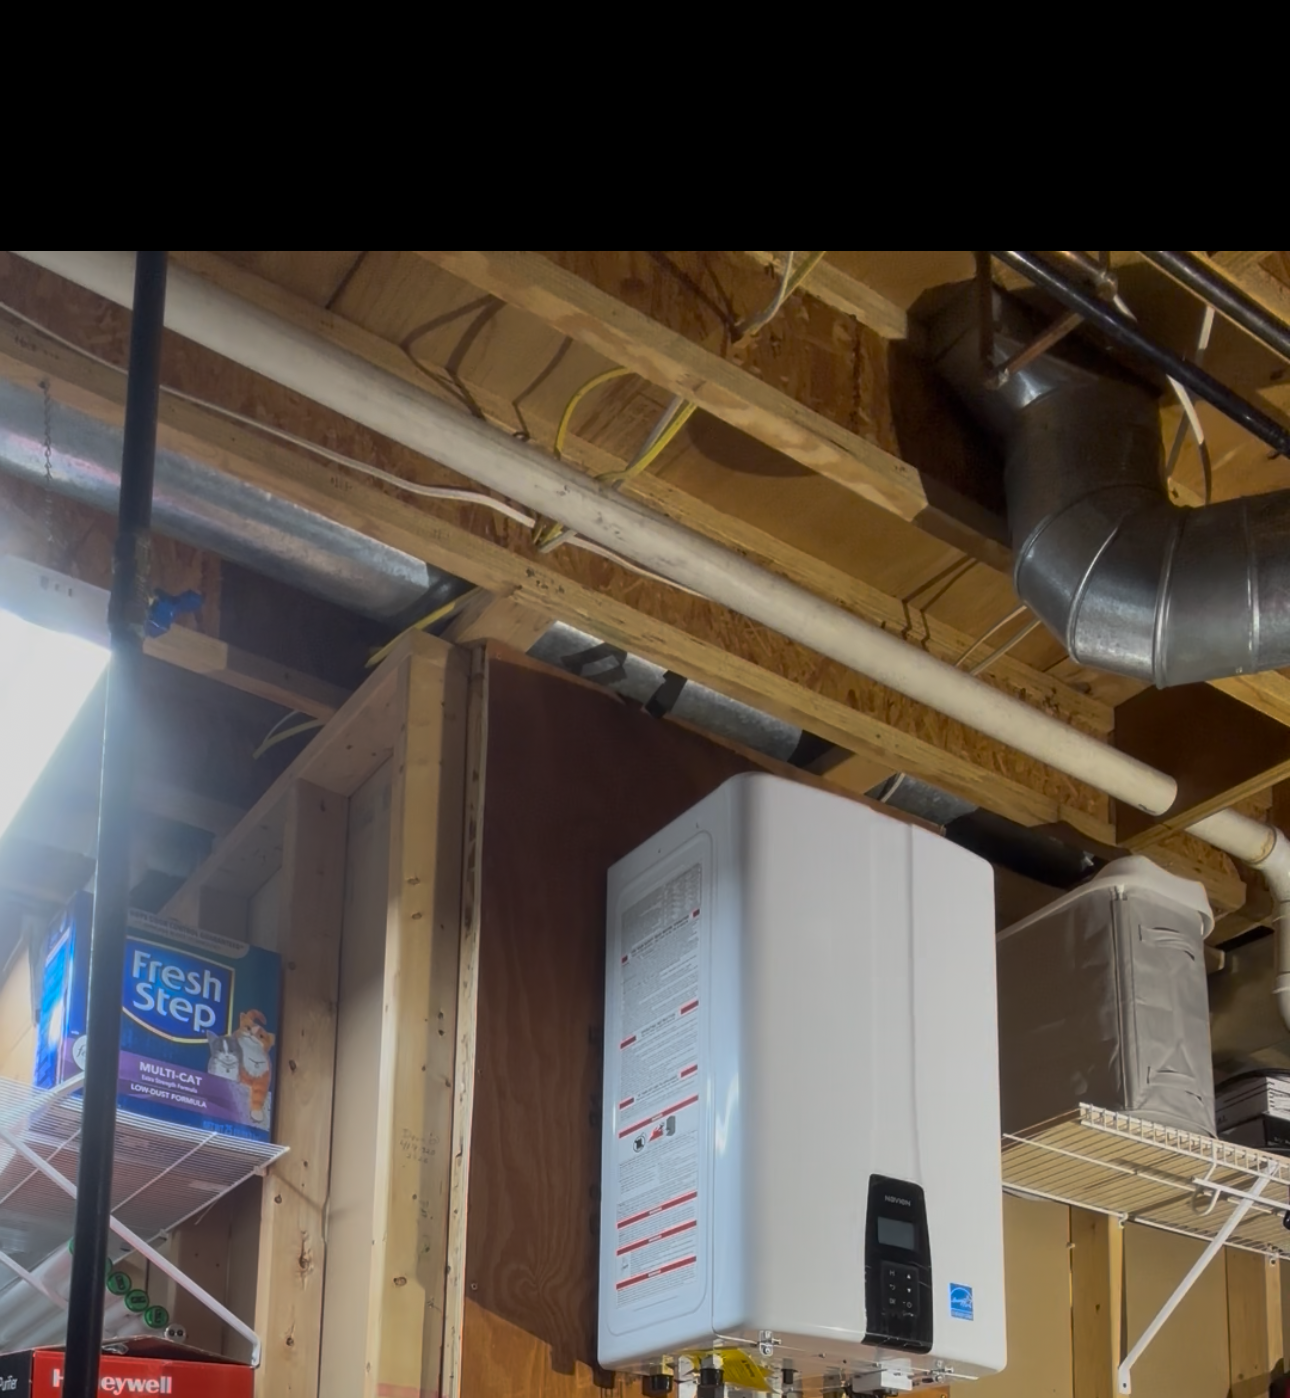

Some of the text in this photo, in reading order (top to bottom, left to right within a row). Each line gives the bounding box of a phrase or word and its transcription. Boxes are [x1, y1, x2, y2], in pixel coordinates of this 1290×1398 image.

[132, 950, 222, 1004] Fresh
[132, 982, 216, 1033] Step
[139, 1061, 203, 1087] MULTI-CAT
[130, 1083, 208, 1109] LOW-DUST FORMULA
[52, 1368, 173, 1396] Heywell
